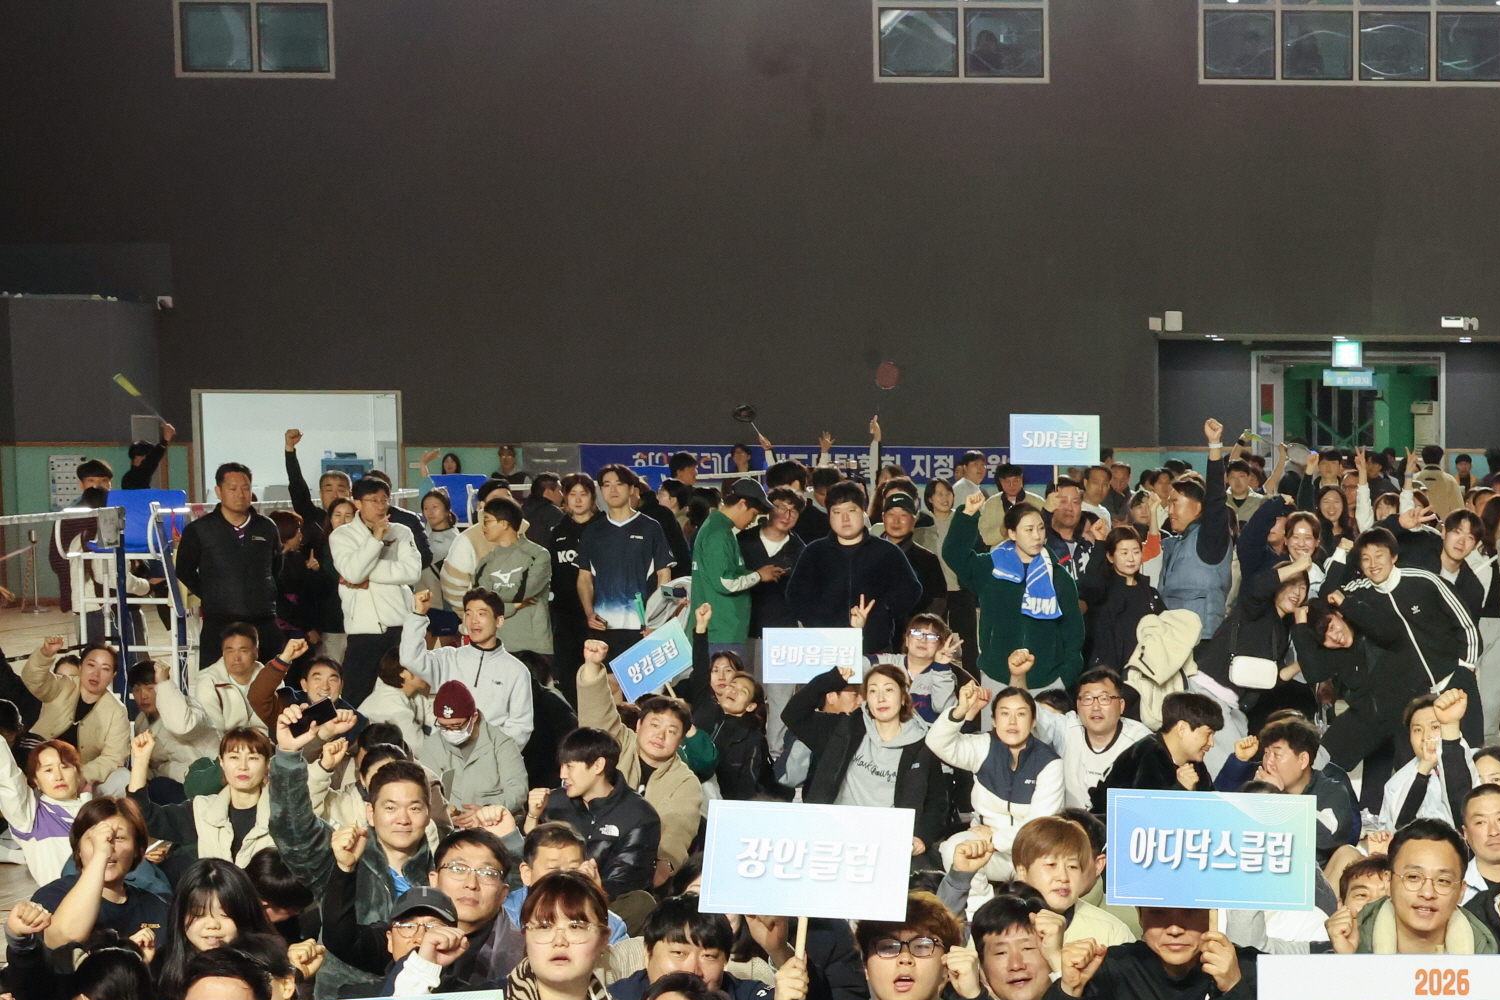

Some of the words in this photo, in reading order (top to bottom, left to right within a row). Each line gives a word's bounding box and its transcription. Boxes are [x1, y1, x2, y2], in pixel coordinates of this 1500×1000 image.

[1021, 430, 1089, 450] SDR클럽
[911, 454, 954, 478] 지정
[627, 638, 679, 684] 양감클럽
[770, 644, 856, 667] 한마음클럽
[736, 837, 879, 884] 장안클럽
[1129, 827, 1294, 874] 아디닥스클럽
[1415, 969, 1470, 996] 2026
